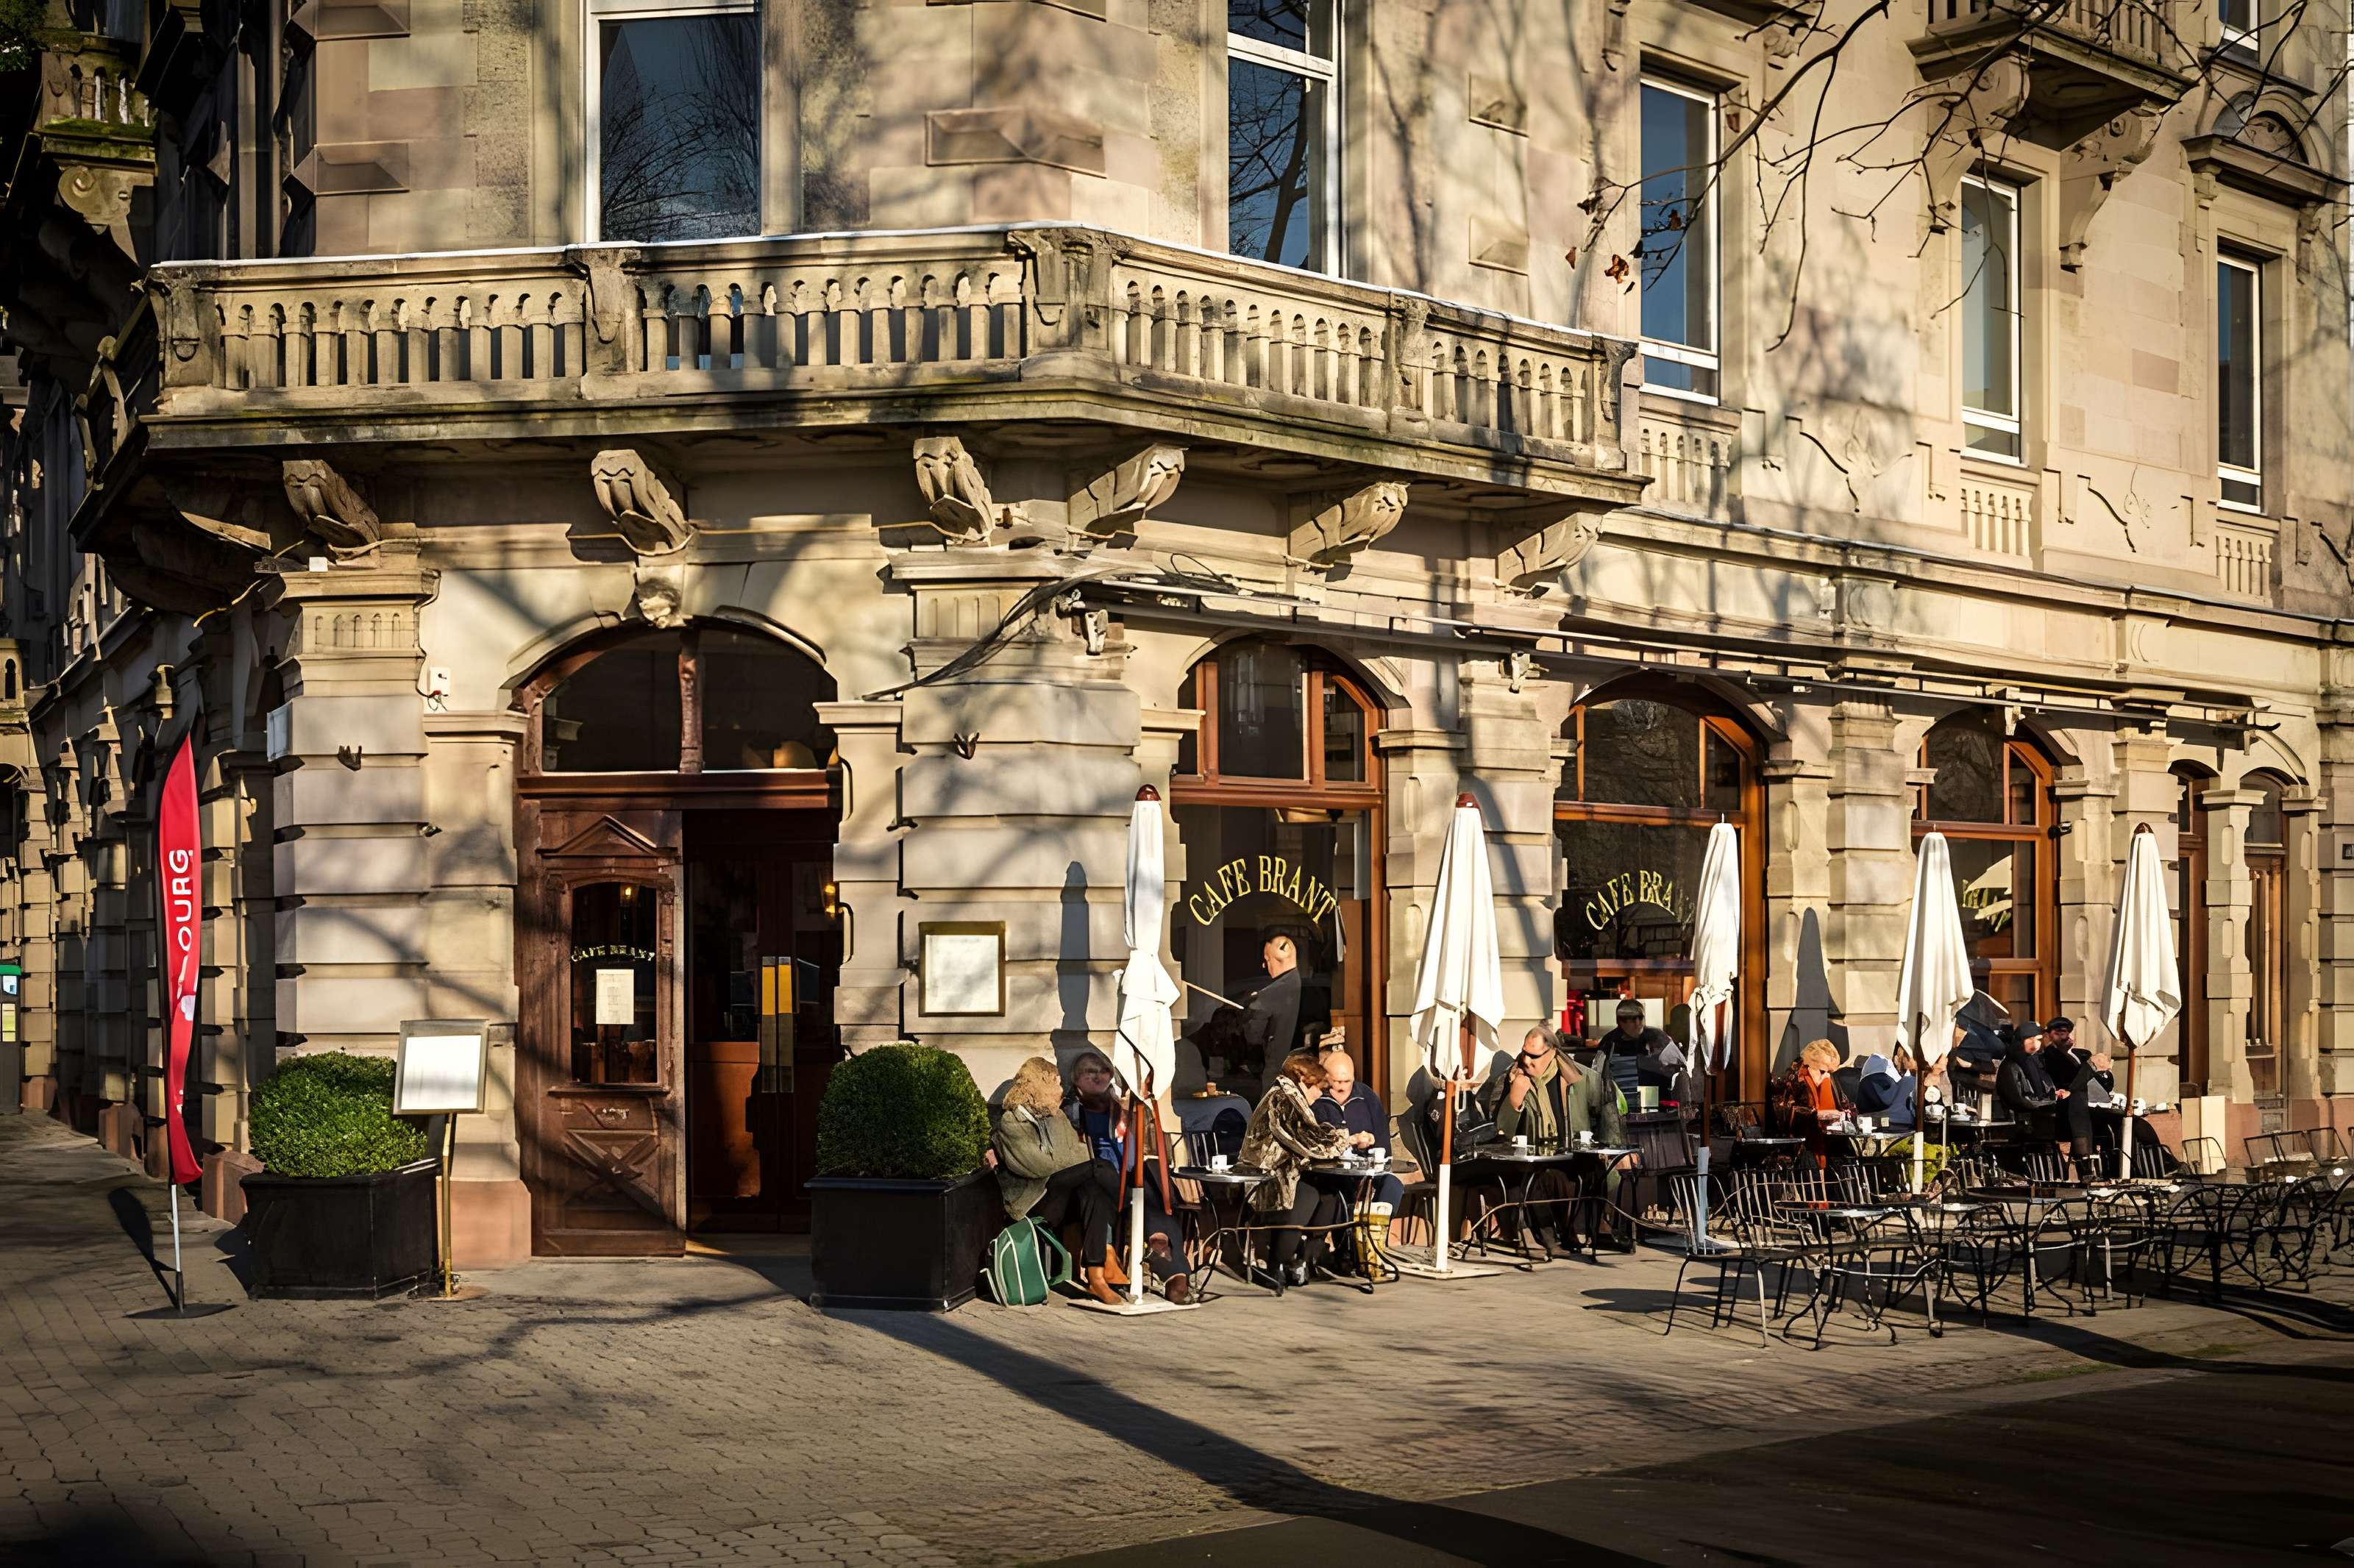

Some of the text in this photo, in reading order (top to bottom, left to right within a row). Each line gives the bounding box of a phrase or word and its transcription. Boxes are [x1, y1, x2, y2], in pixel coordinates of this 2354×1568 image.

[168, 849, 193, 989] OURG
[1189, 855, 1337, 926] CAFE BRANT
